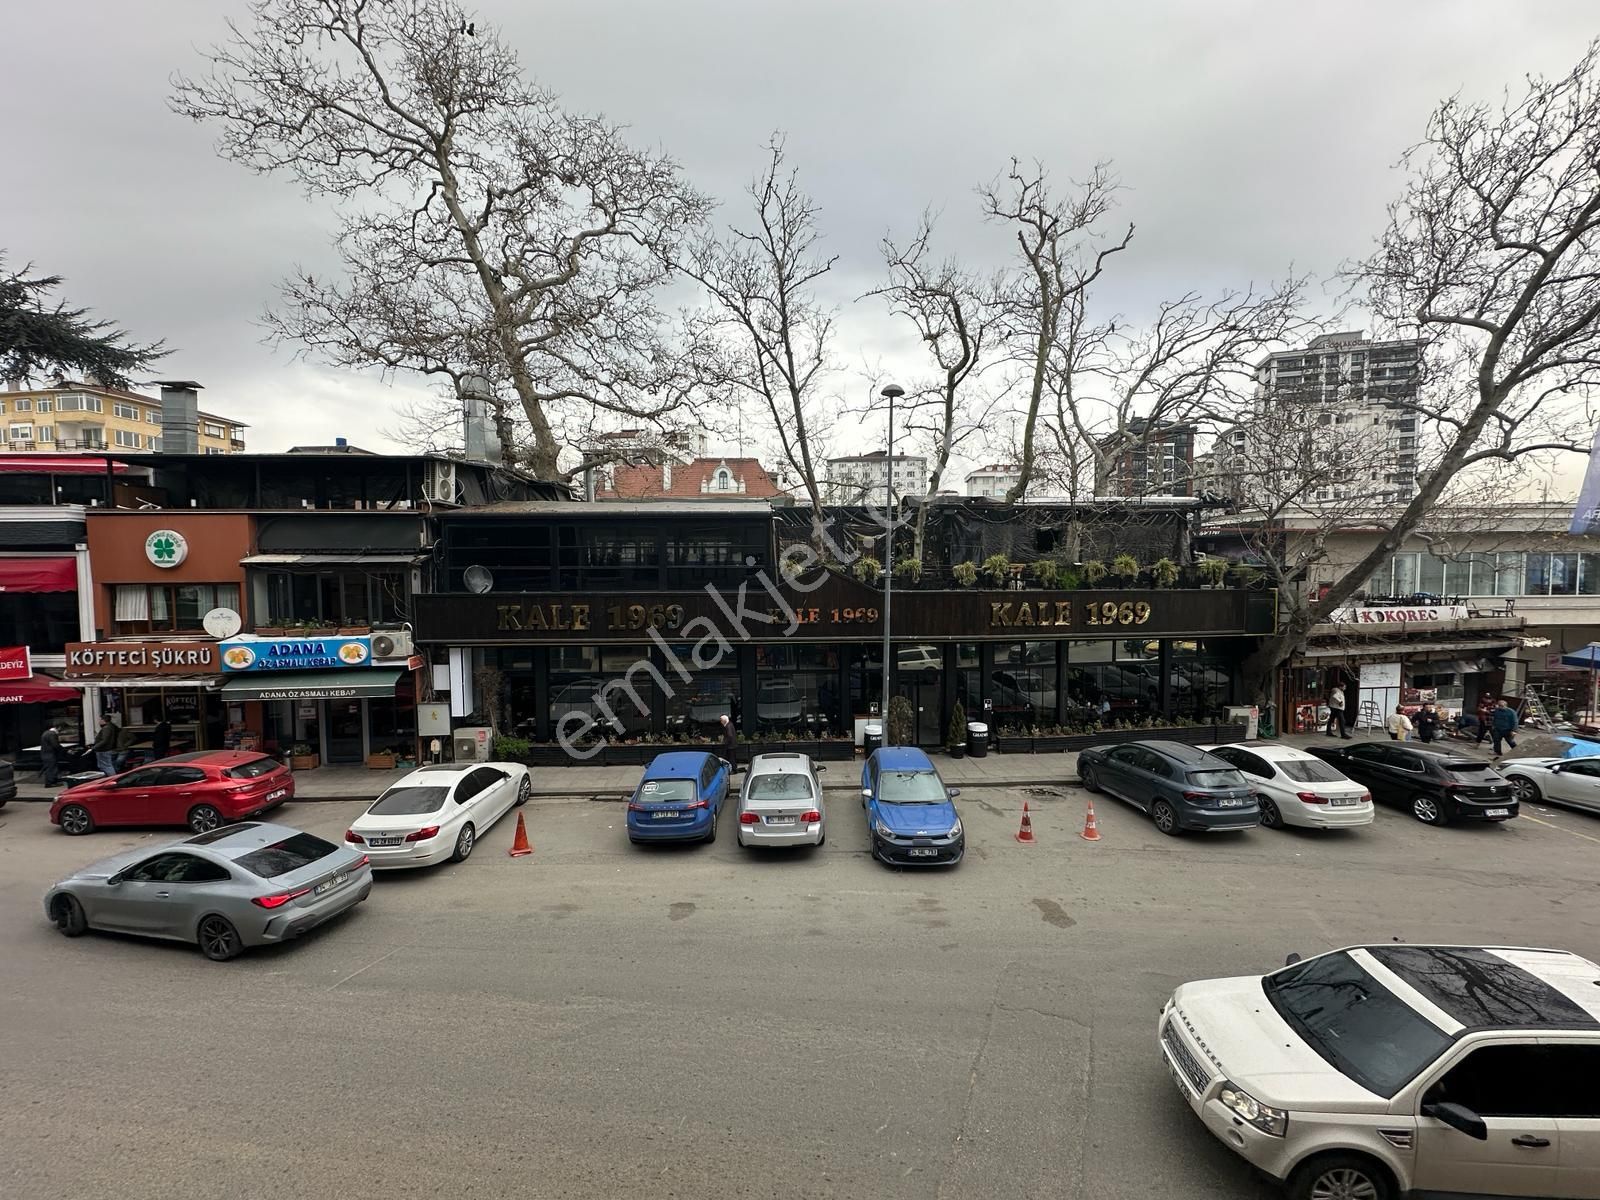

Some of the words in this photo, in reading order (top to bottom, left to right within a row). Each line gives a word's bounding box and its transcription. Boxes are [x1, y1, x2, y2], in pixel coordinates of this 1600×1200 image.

[496, 604, 591, 630] KALE
[607, 604, 684, 630] 1969
[831, 607, 879, 623] 1969
[990, 601, 1071, 626] KALE
[1086, 601, 1151, 625] 1969
[70, 648, 147, 665] KÖFTECİ
[151, 648, 211, 668] ŞÜKRÜ
[268, 643, 326, 657] ADANA
[0, 659, 25, 670] DEYİZ
[258, 658, 273, 668] ÖZ
[273, 658, 307, 668] ASMALI
[308, 656, 337, 667] KEBAP
[259, 691, 287, 699] ADANA
[288, 690, 299, 698] ÖZ
[299, 690, 329, 698] ASMALI
[329, 689, 356, 697] KEBAP
[1179, 1010, 1195, 1033] LAND
[1195, 1035, 1223, 1068] ROVER
